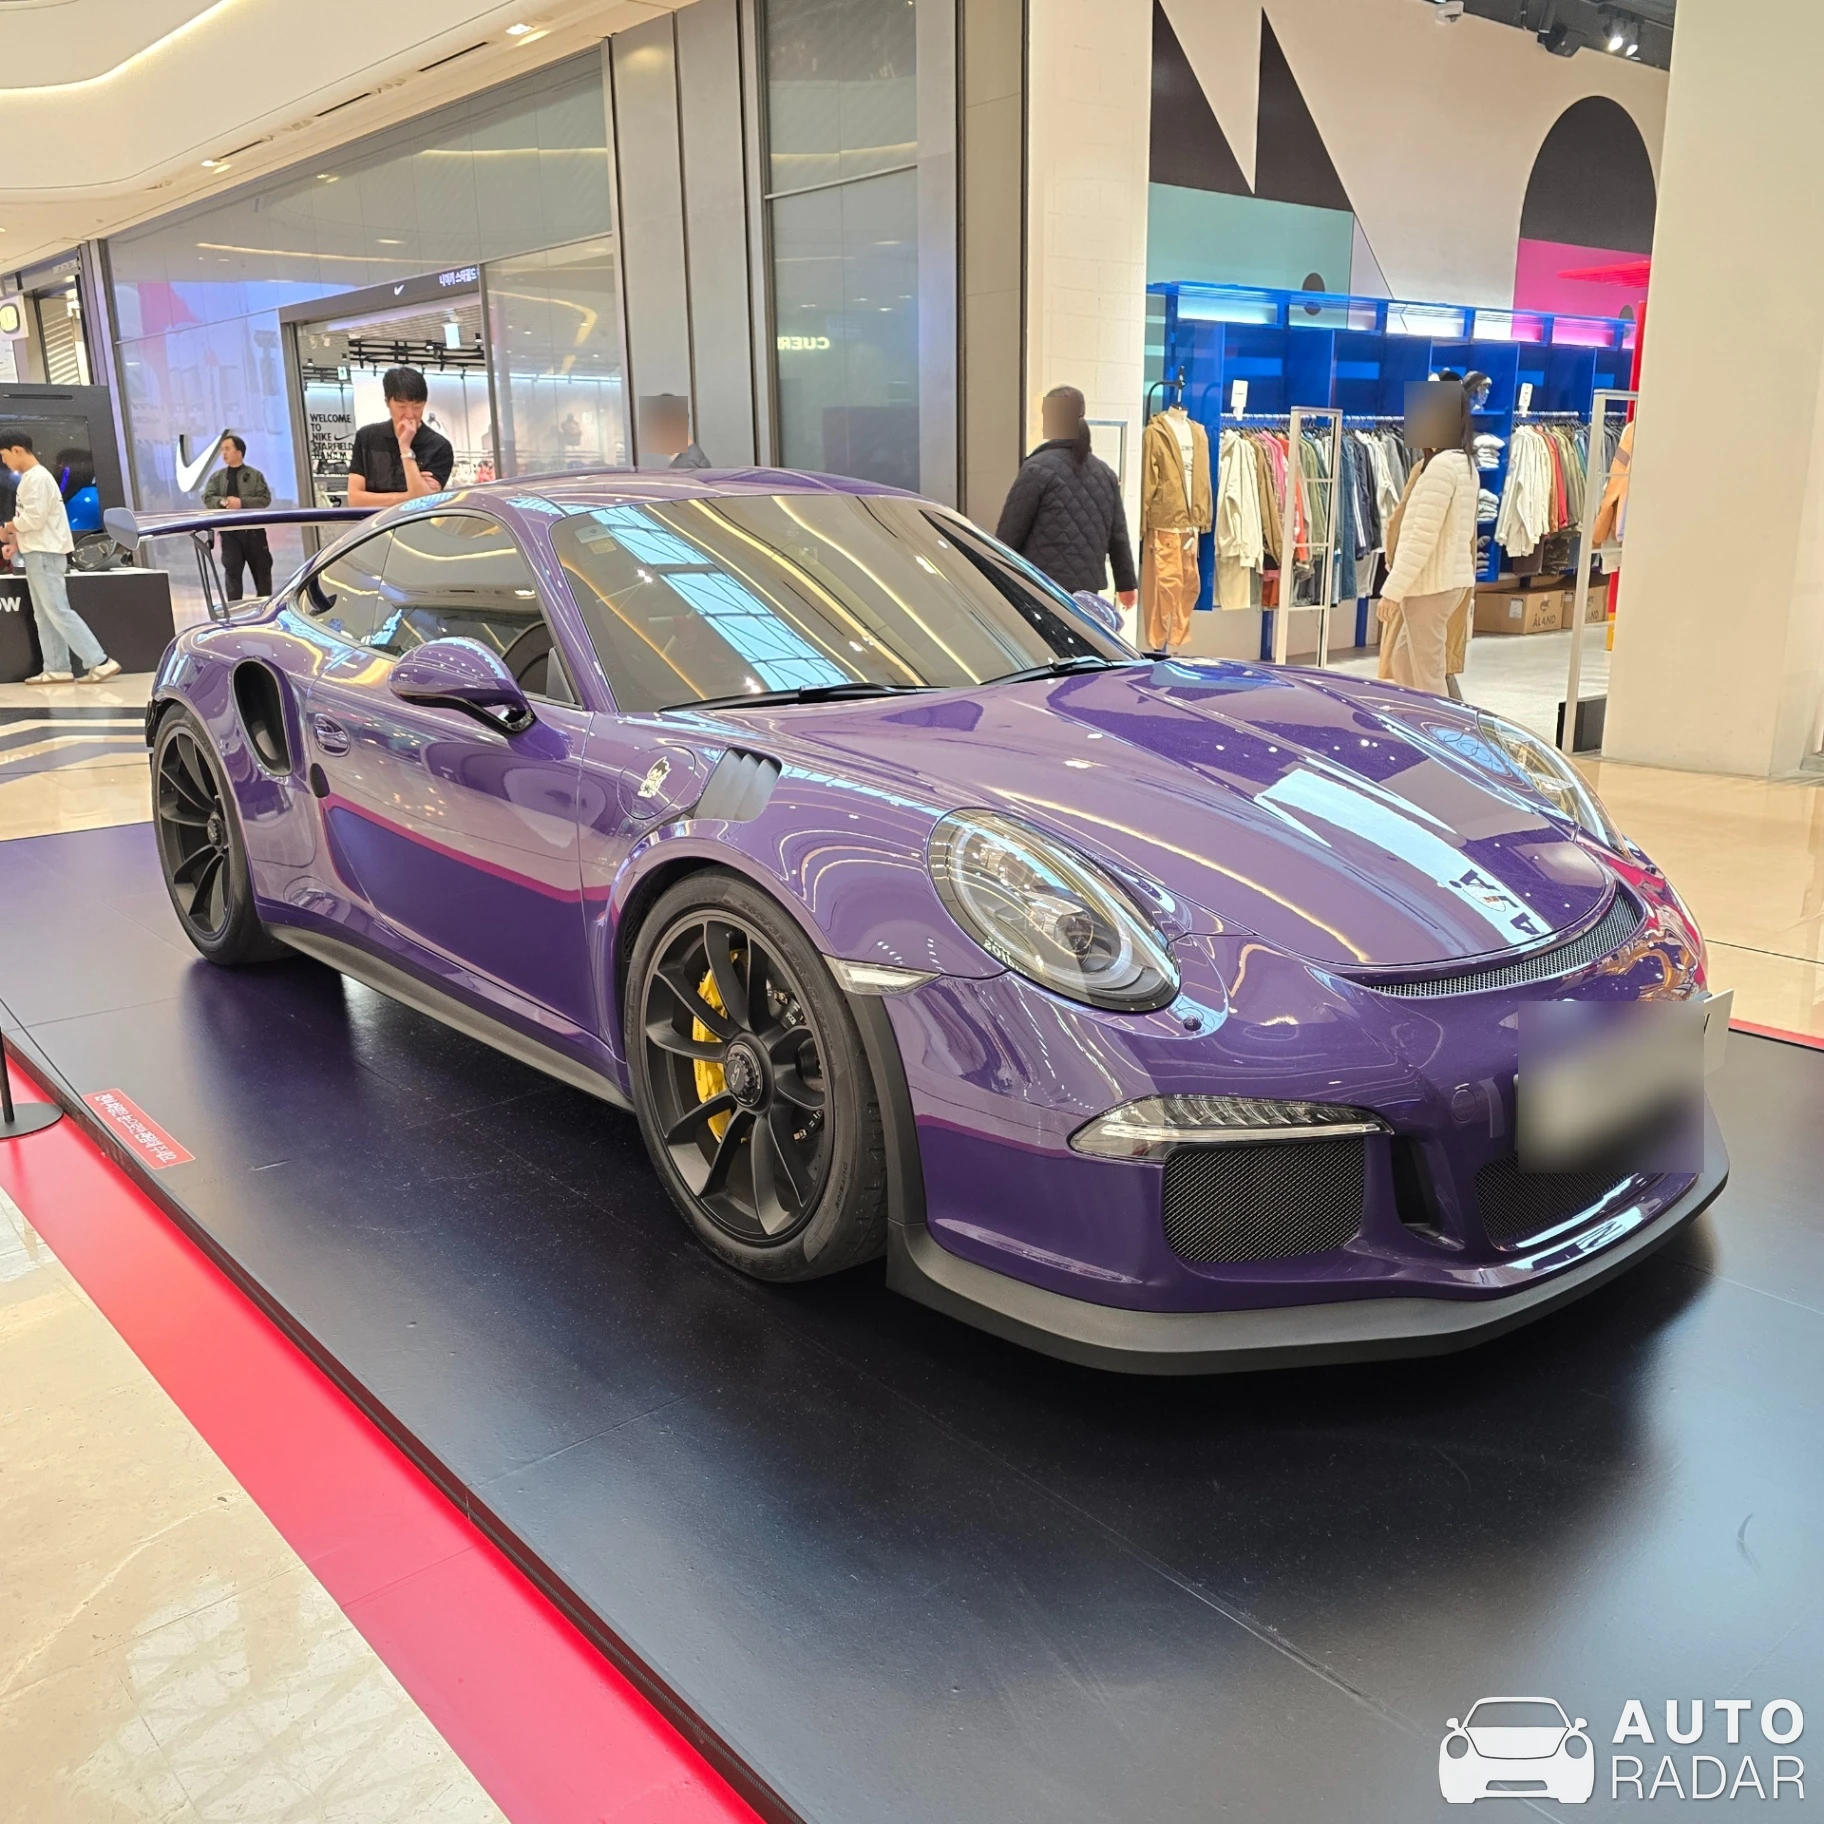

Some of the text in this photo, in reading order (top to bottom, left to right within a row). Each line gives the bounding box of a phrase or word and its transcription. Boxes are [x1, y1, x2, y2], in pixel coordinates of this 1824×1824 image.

[310, 413, 352, 423] WELCOME
[310, 423, 321, 432] TO
[312, 433, 332, 441] NIKE
